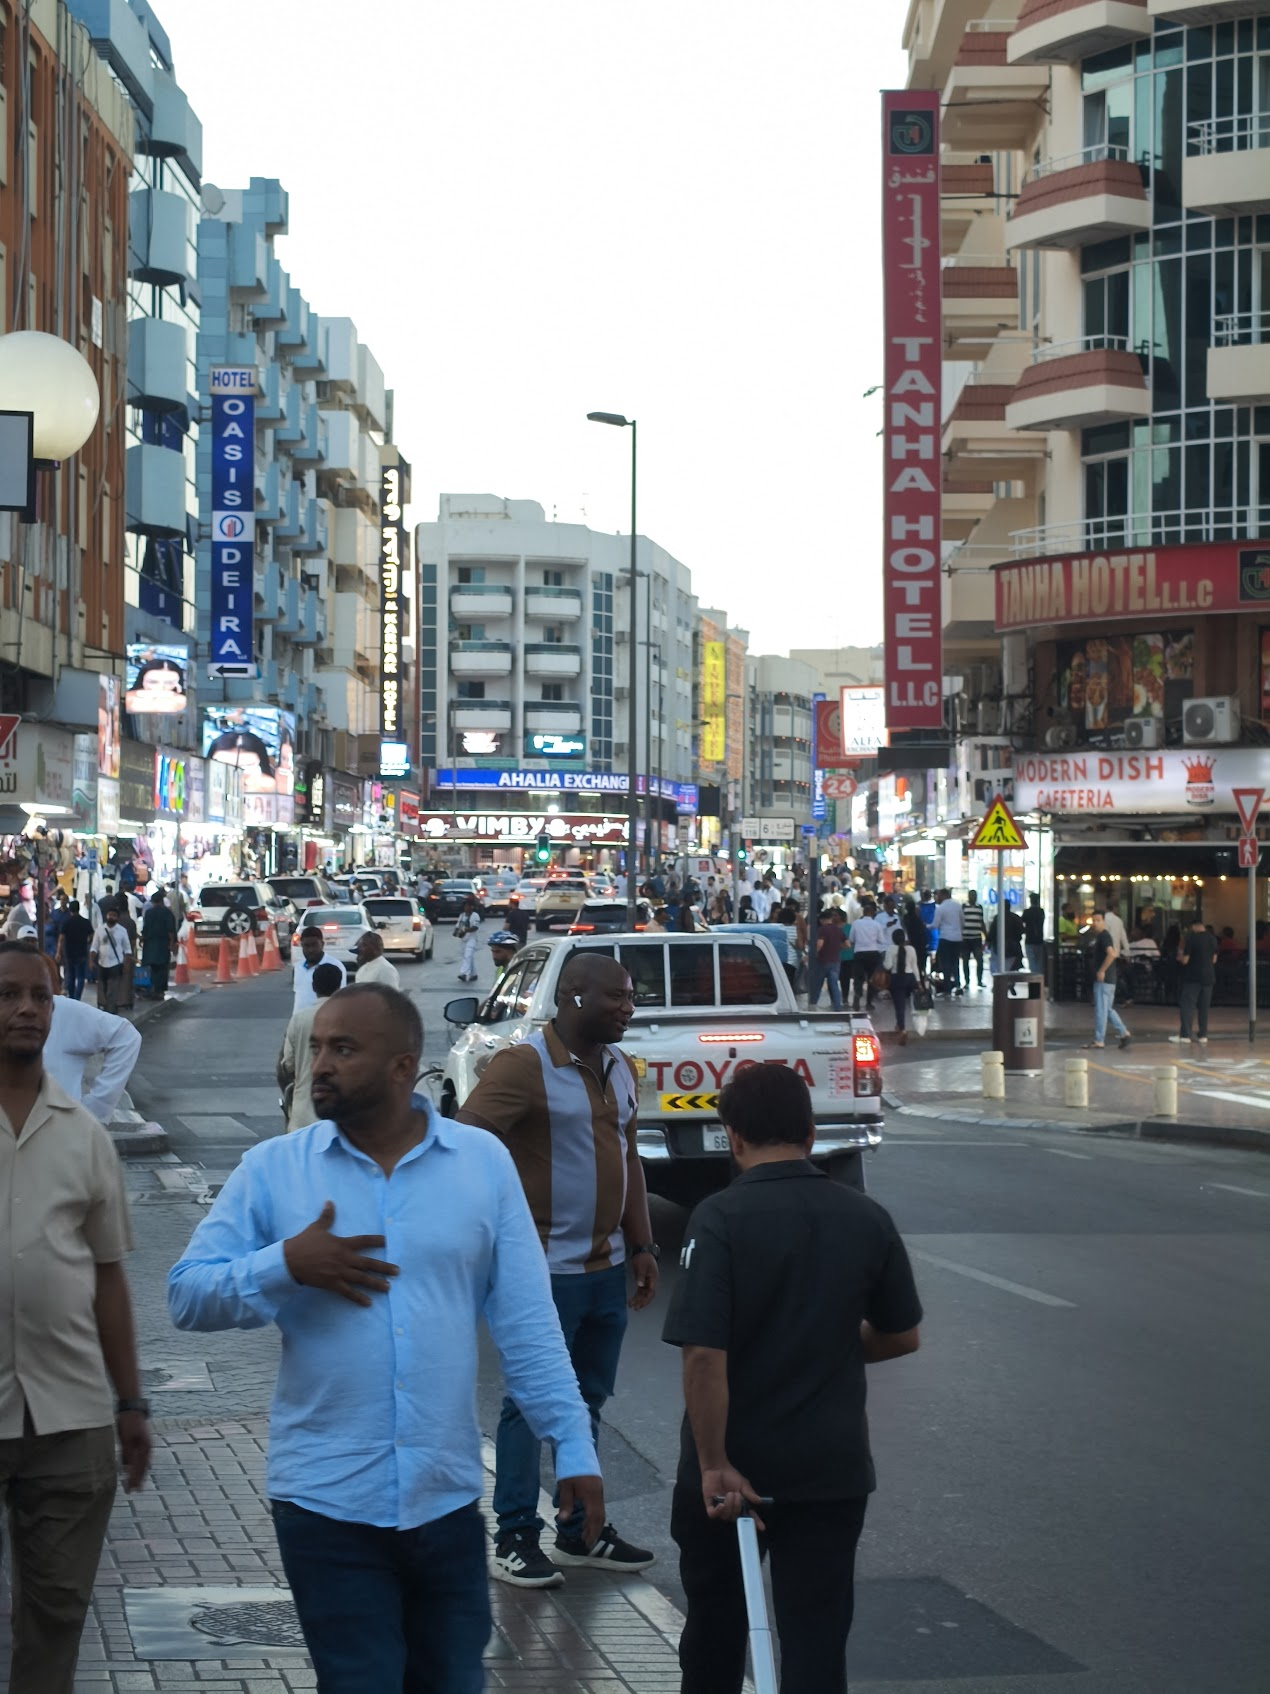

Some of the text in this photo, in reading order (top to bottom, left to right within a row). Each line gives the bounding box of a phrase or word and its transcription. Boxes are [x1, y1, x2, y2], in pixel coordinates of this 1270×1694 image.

[212, 371, 255, 387] HOTEL
[890, 337, 936, 670] TANHA HOTEL
[219, 400, 246, 655] OASIS DEIRA
[1001, 562, 1066, 624] TANHA
[1072, 553, 1160, 615] HOTEL
[383, 680, 398, 731] HOTEL
[890, 681, 939, 707] L.L.C
[498, 772, 561, 788] AHALIA
[1015, 756, 1164, 783] MODERN DISH
[826, 779, 852, 794] 24
[1037, 789, 1114, 809] CAFETERIA
[456, 816, 545, 836] VIMBY
